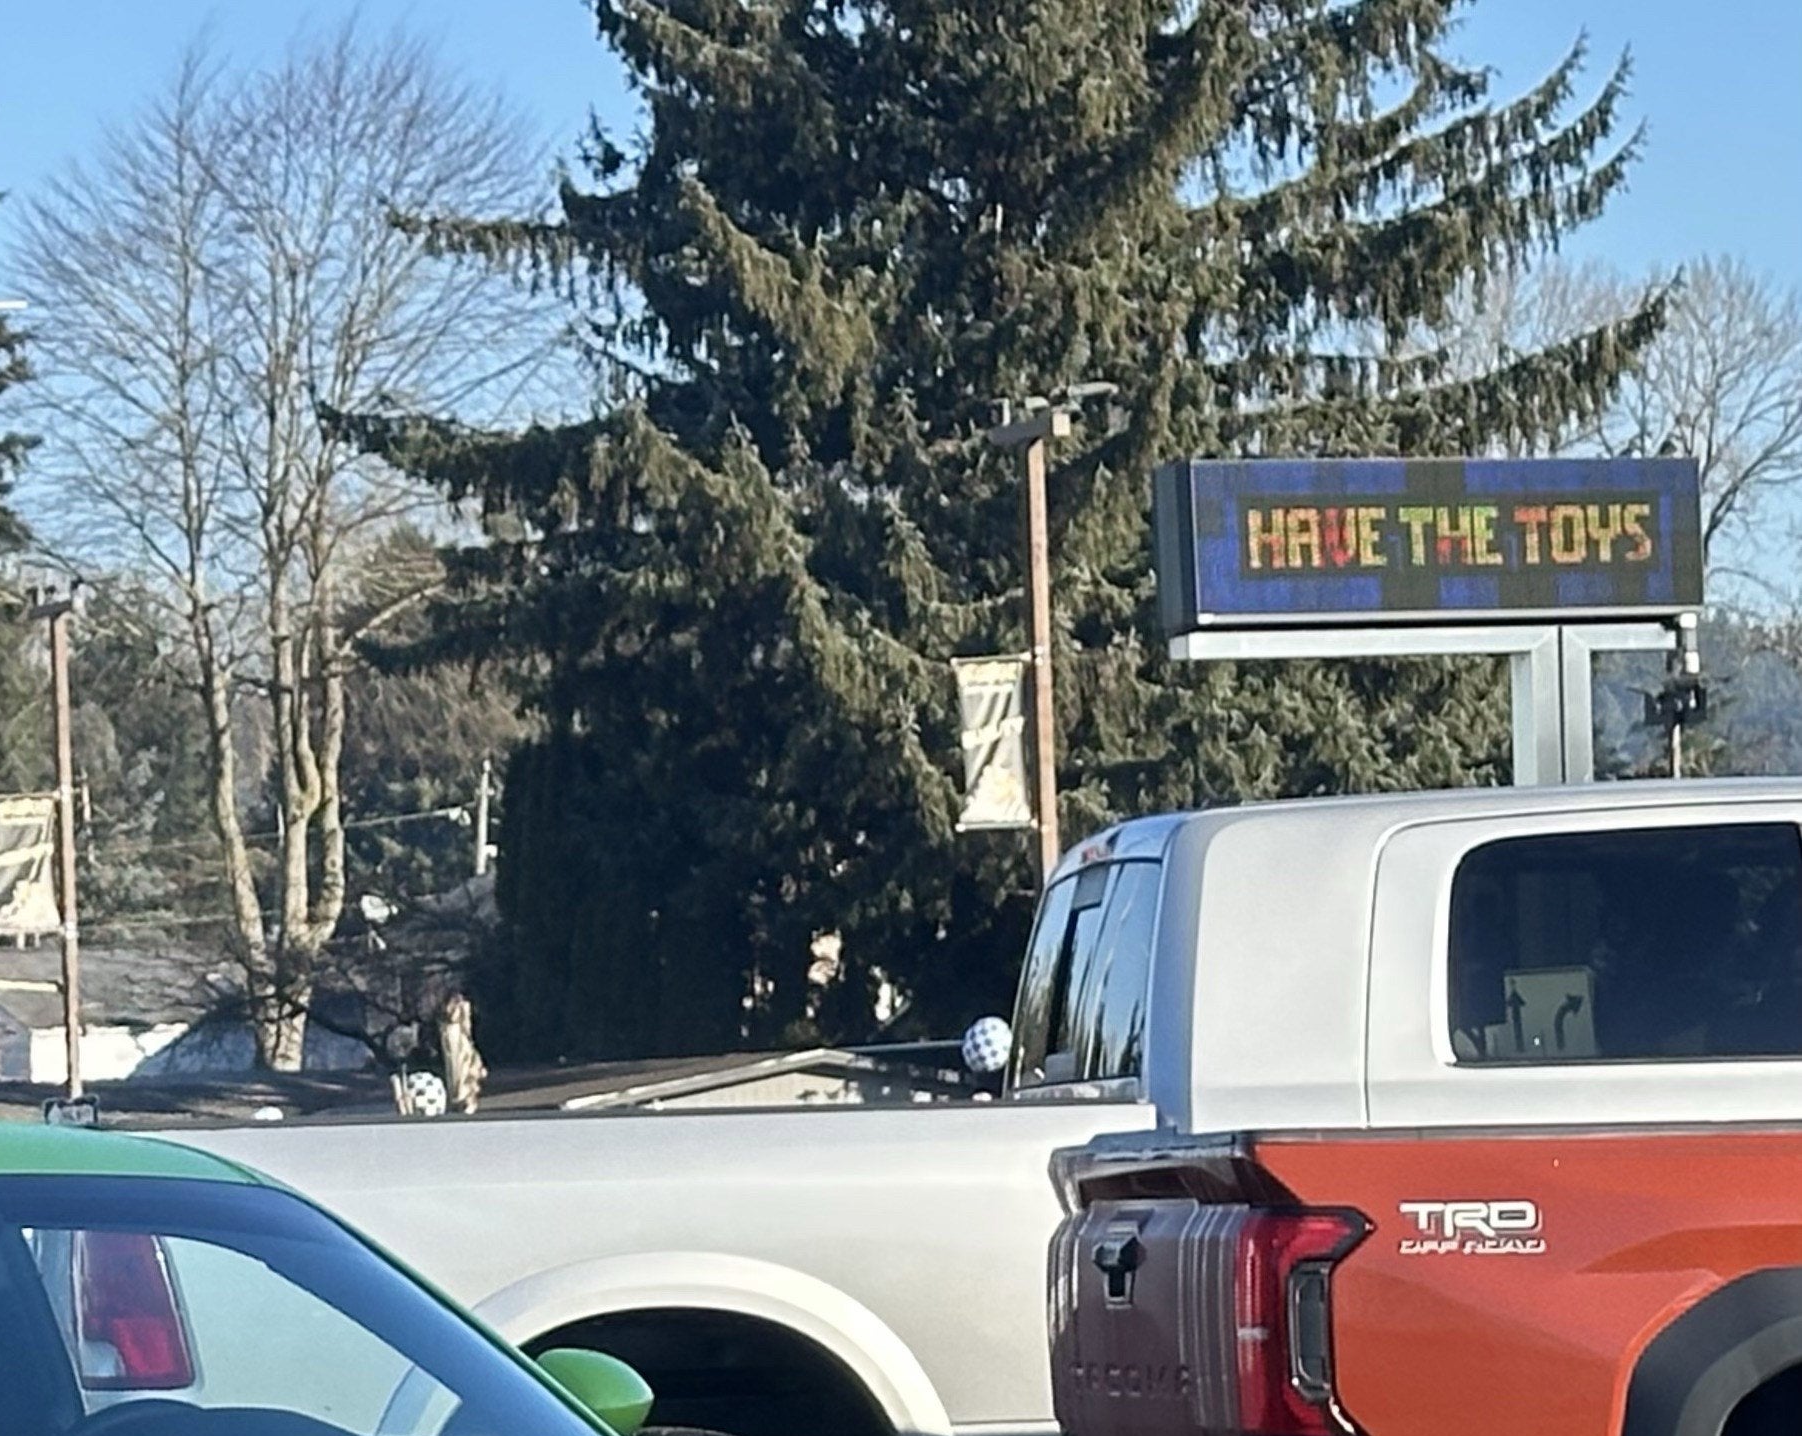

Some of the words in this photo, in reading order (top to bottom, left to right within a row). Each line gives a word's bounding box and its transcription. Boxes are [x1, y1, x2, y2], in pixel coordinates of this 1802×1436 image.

[1247, 506, 1388, 569] HAVE
[1398, 504, 1503, 567] THE
[1514, 503, 1652, 566] TOYS
[1399, 1201, 1541, 1238] TRD
